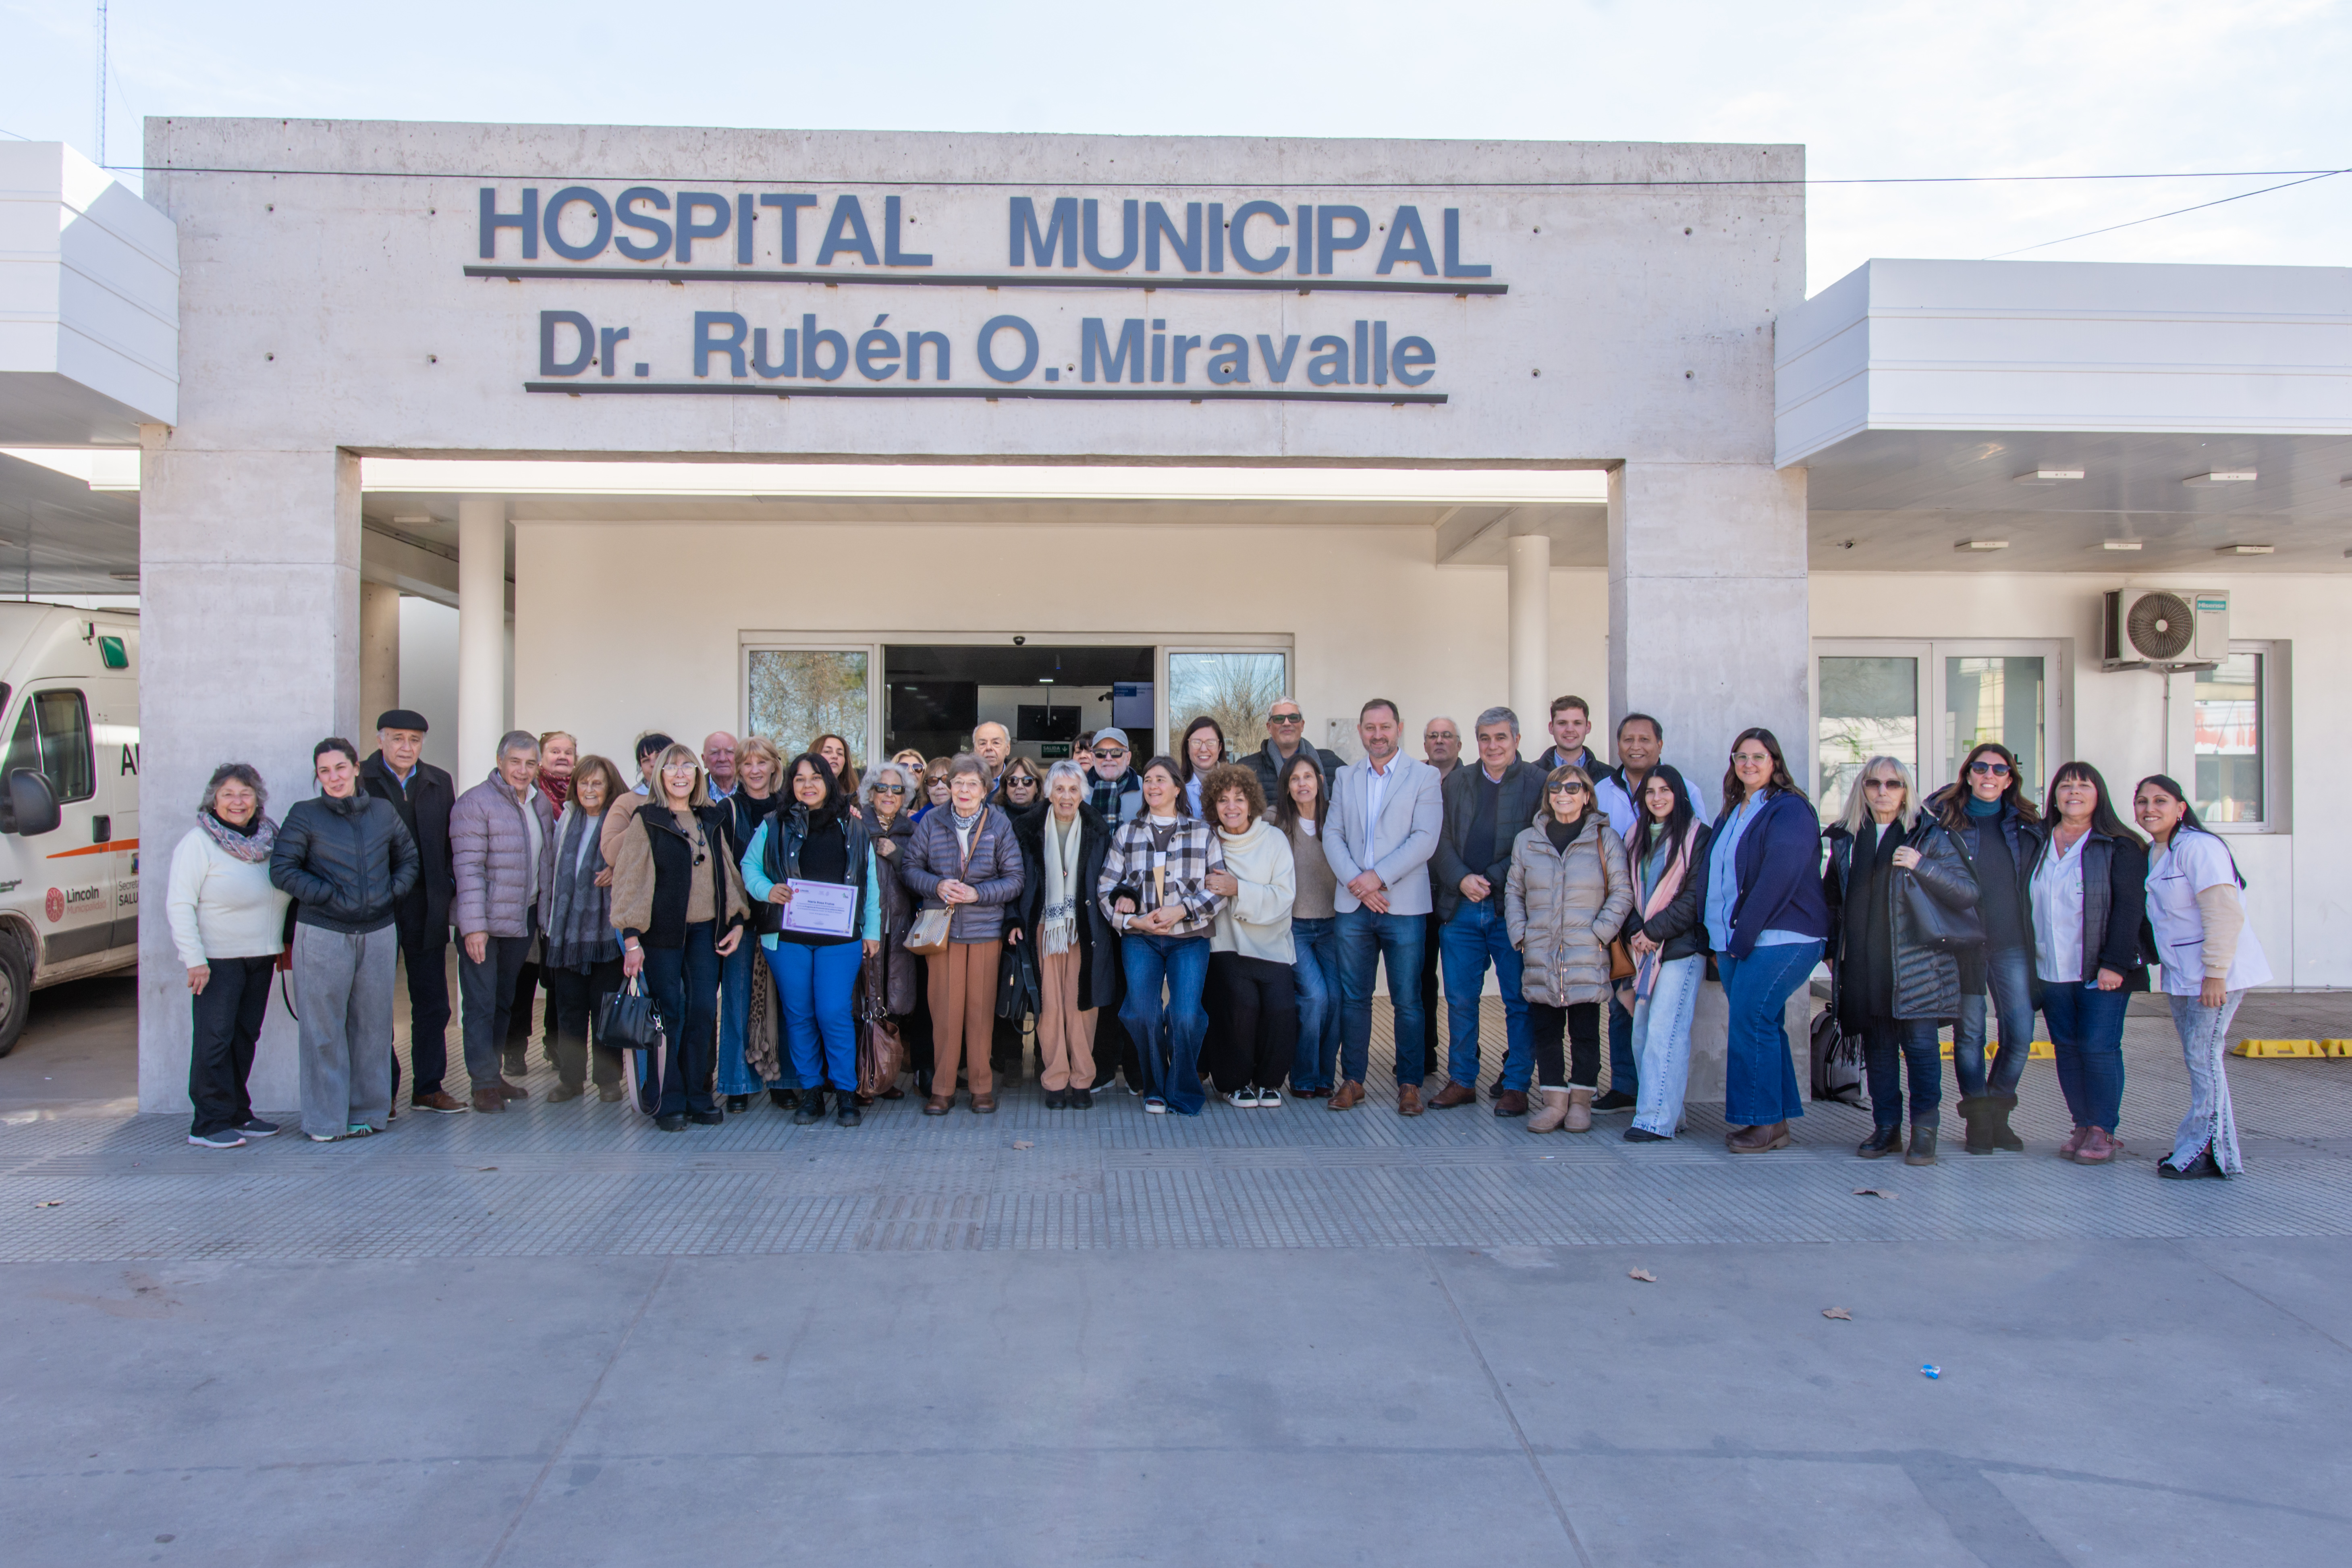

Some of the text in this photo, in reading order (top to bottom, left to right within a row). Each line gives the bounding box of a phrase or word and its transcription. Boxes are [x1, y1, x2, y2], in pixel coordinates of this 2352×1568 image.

[480, 186, 1492, 277] HOSPITAL MUNICIPAL
[540, 310, 1436, 386] Dr. Rubén O. Miravalle
[66, 886, 99, 903] Lincoln
[67, 900, 106, 915] Municipalidad
